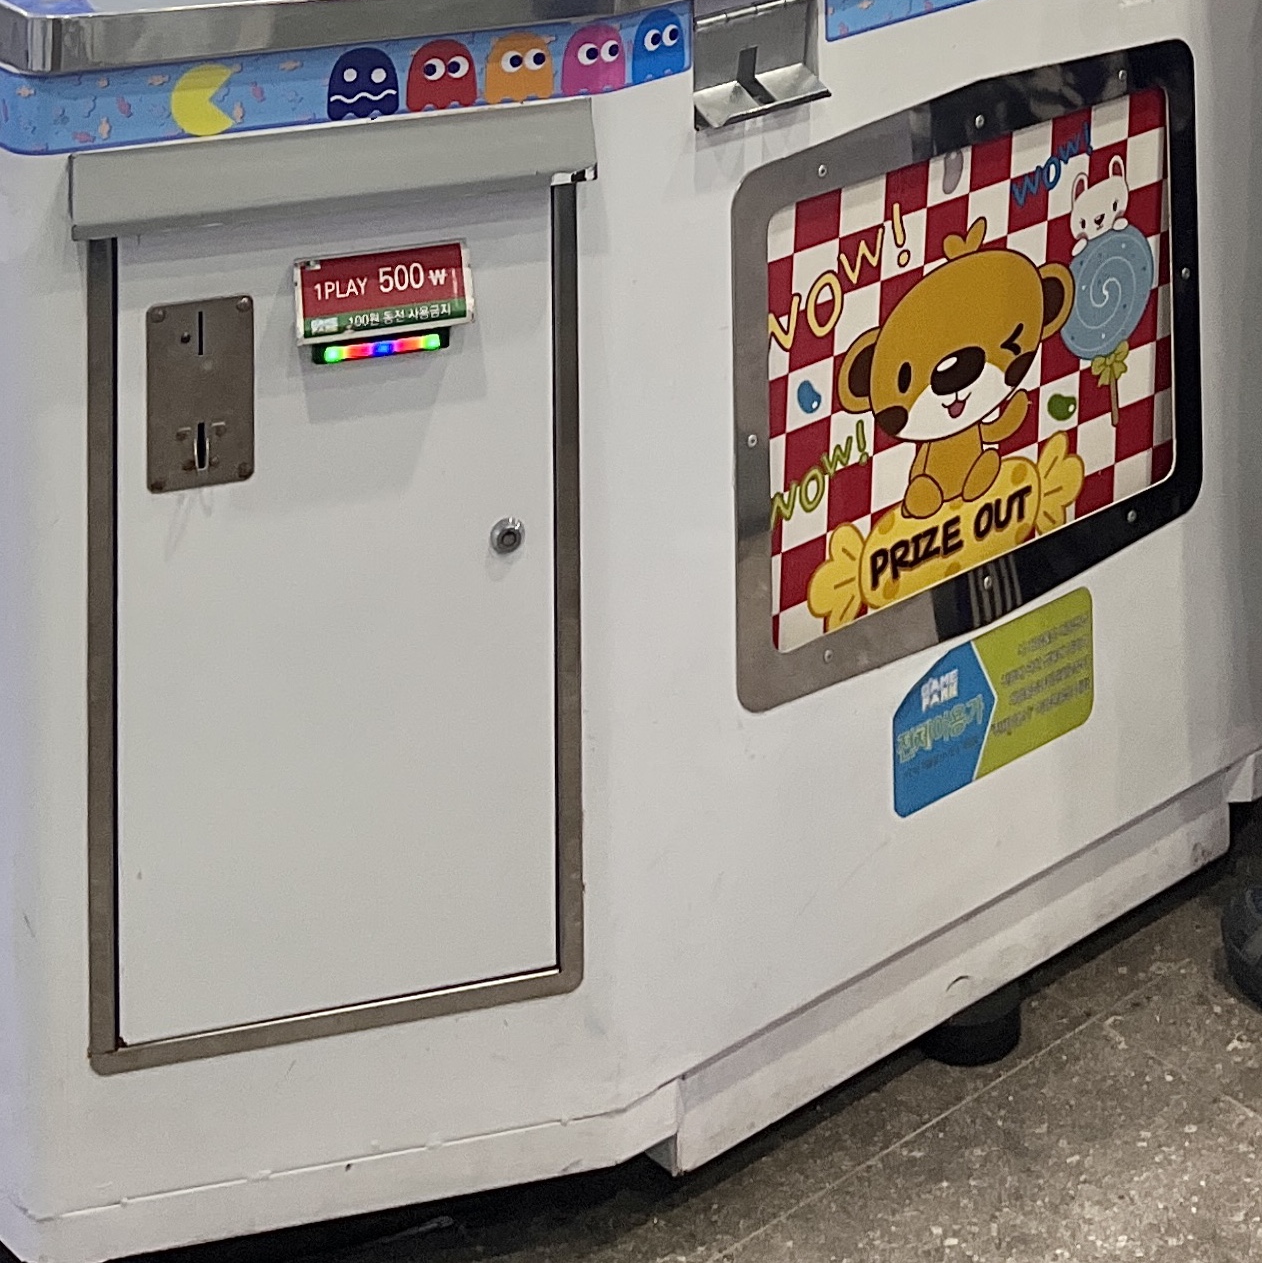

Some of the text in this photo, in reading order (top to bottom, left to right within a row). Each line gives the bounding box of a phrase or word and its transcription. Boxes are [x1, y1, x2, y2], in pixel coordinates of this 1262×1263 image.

[313, 276, 369, 301] 1PLAY
[870, 484, 1033, 593] PRIZE OUT
